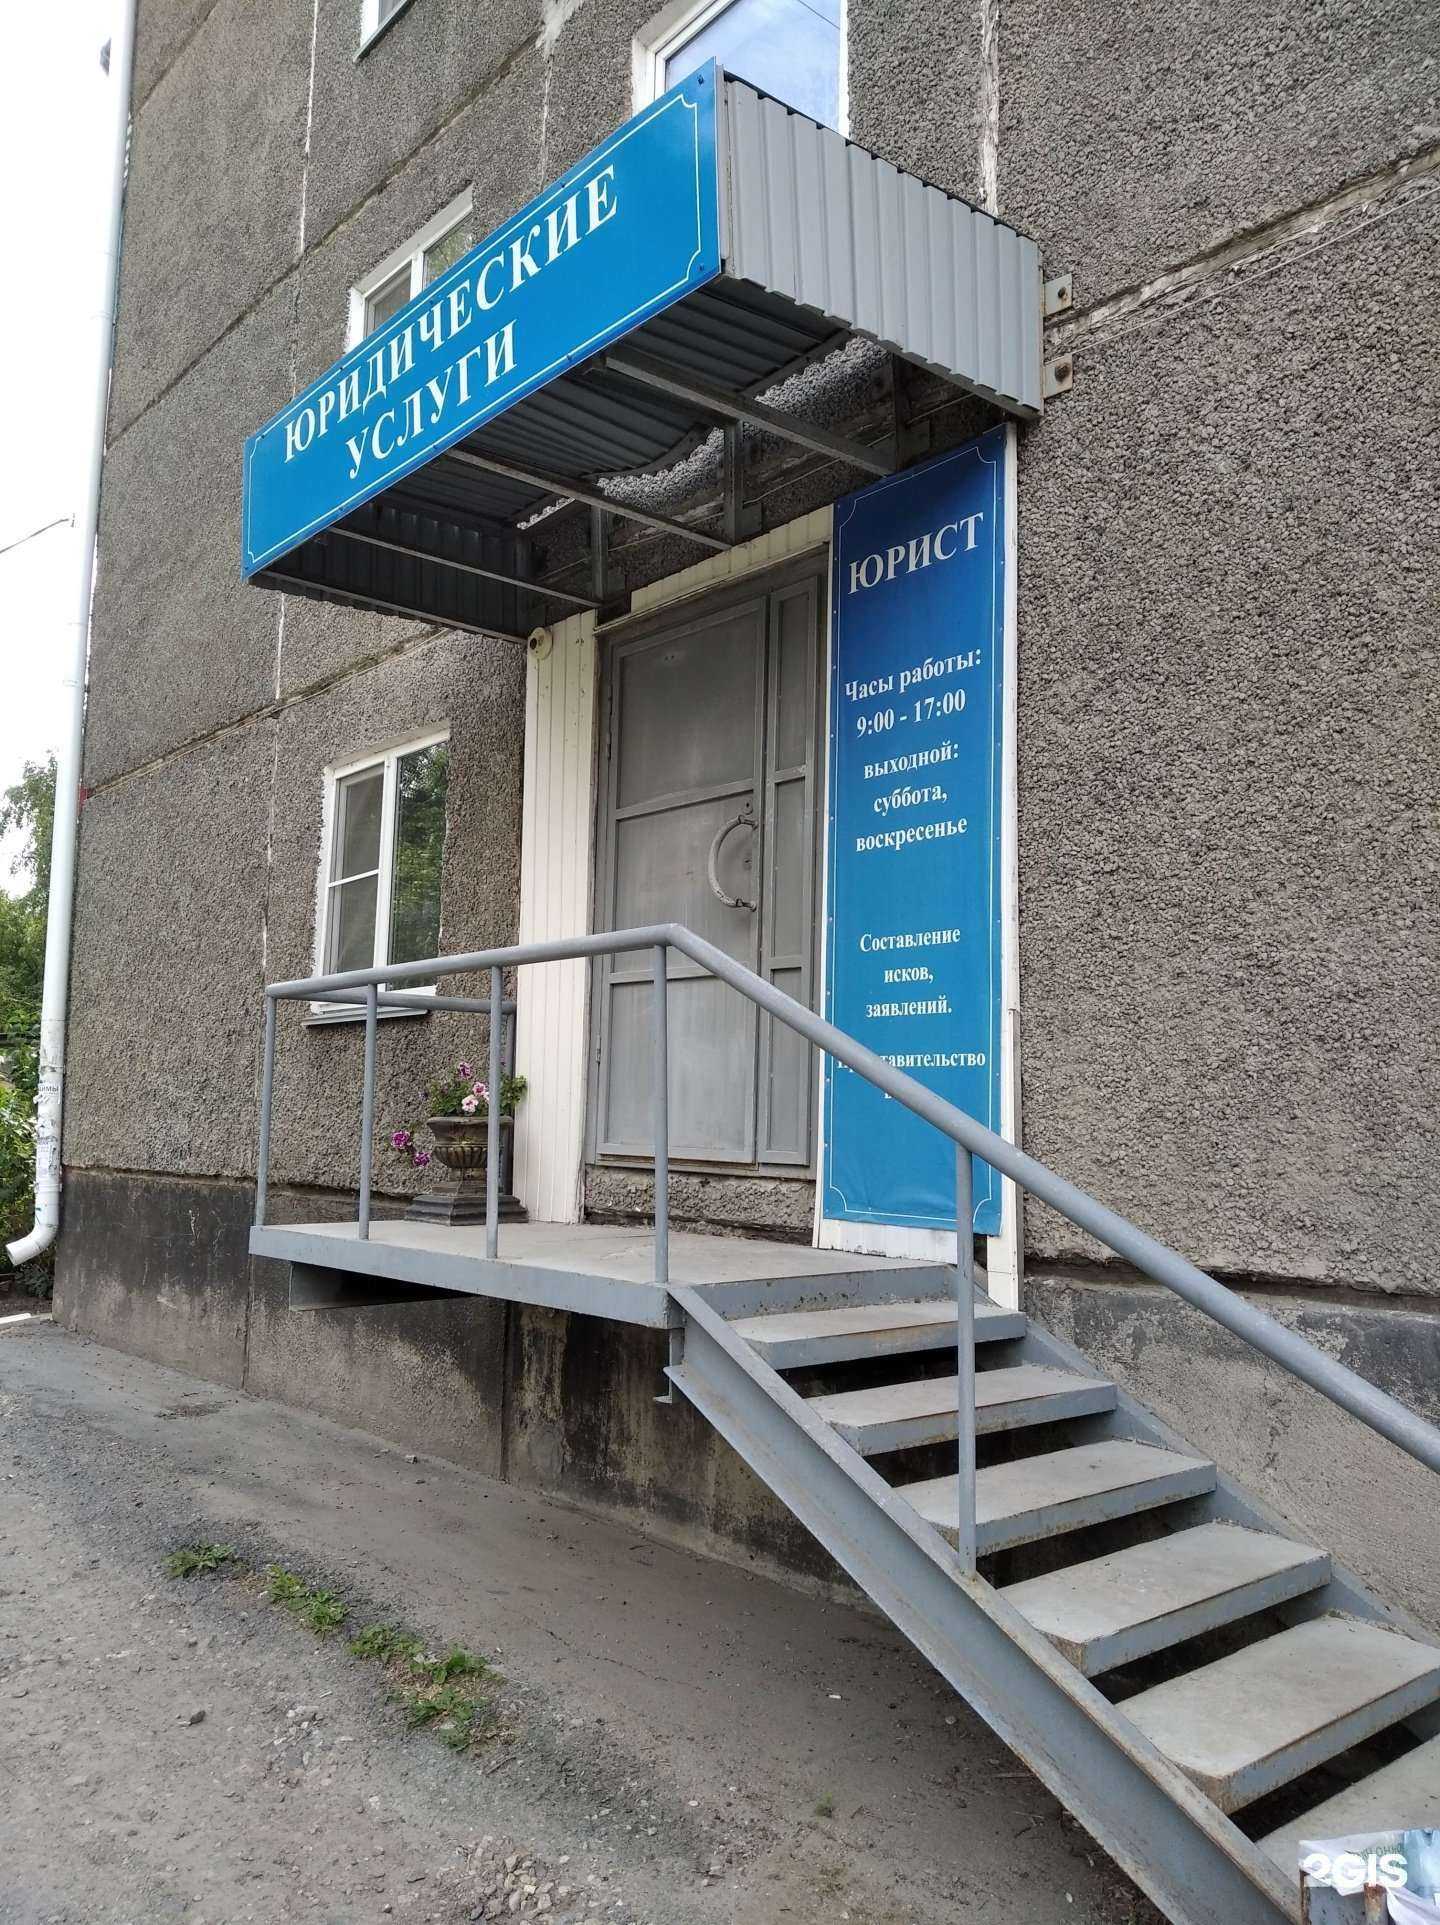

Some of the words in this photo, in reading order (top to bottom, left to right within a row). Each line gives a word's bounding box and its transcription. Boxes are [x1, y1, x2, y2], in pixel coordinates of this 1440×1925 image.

[284, 165, 617, 462] ЮРИДИЧЕСКИЕ
[345, 319, 518, 479] УСЛУГИ
[848, 512, 983, 594] ЮРИСТ
[844, 673, 894, 703] Часы
[898, 647, 982, 693] работы:
[855, 708, 895, 738] 9:00
[912, 688, 966, 724] 17:00
[863, 741, 959, 780] выходной:
[873, 784, 947, 817] суббота,
[855, 816, 968, 853] воскресенье
[860, 928, 960, 952] Составление
[883, 965, 934, 984] исков,
[866, 994, 952, 1018] заявлений.
